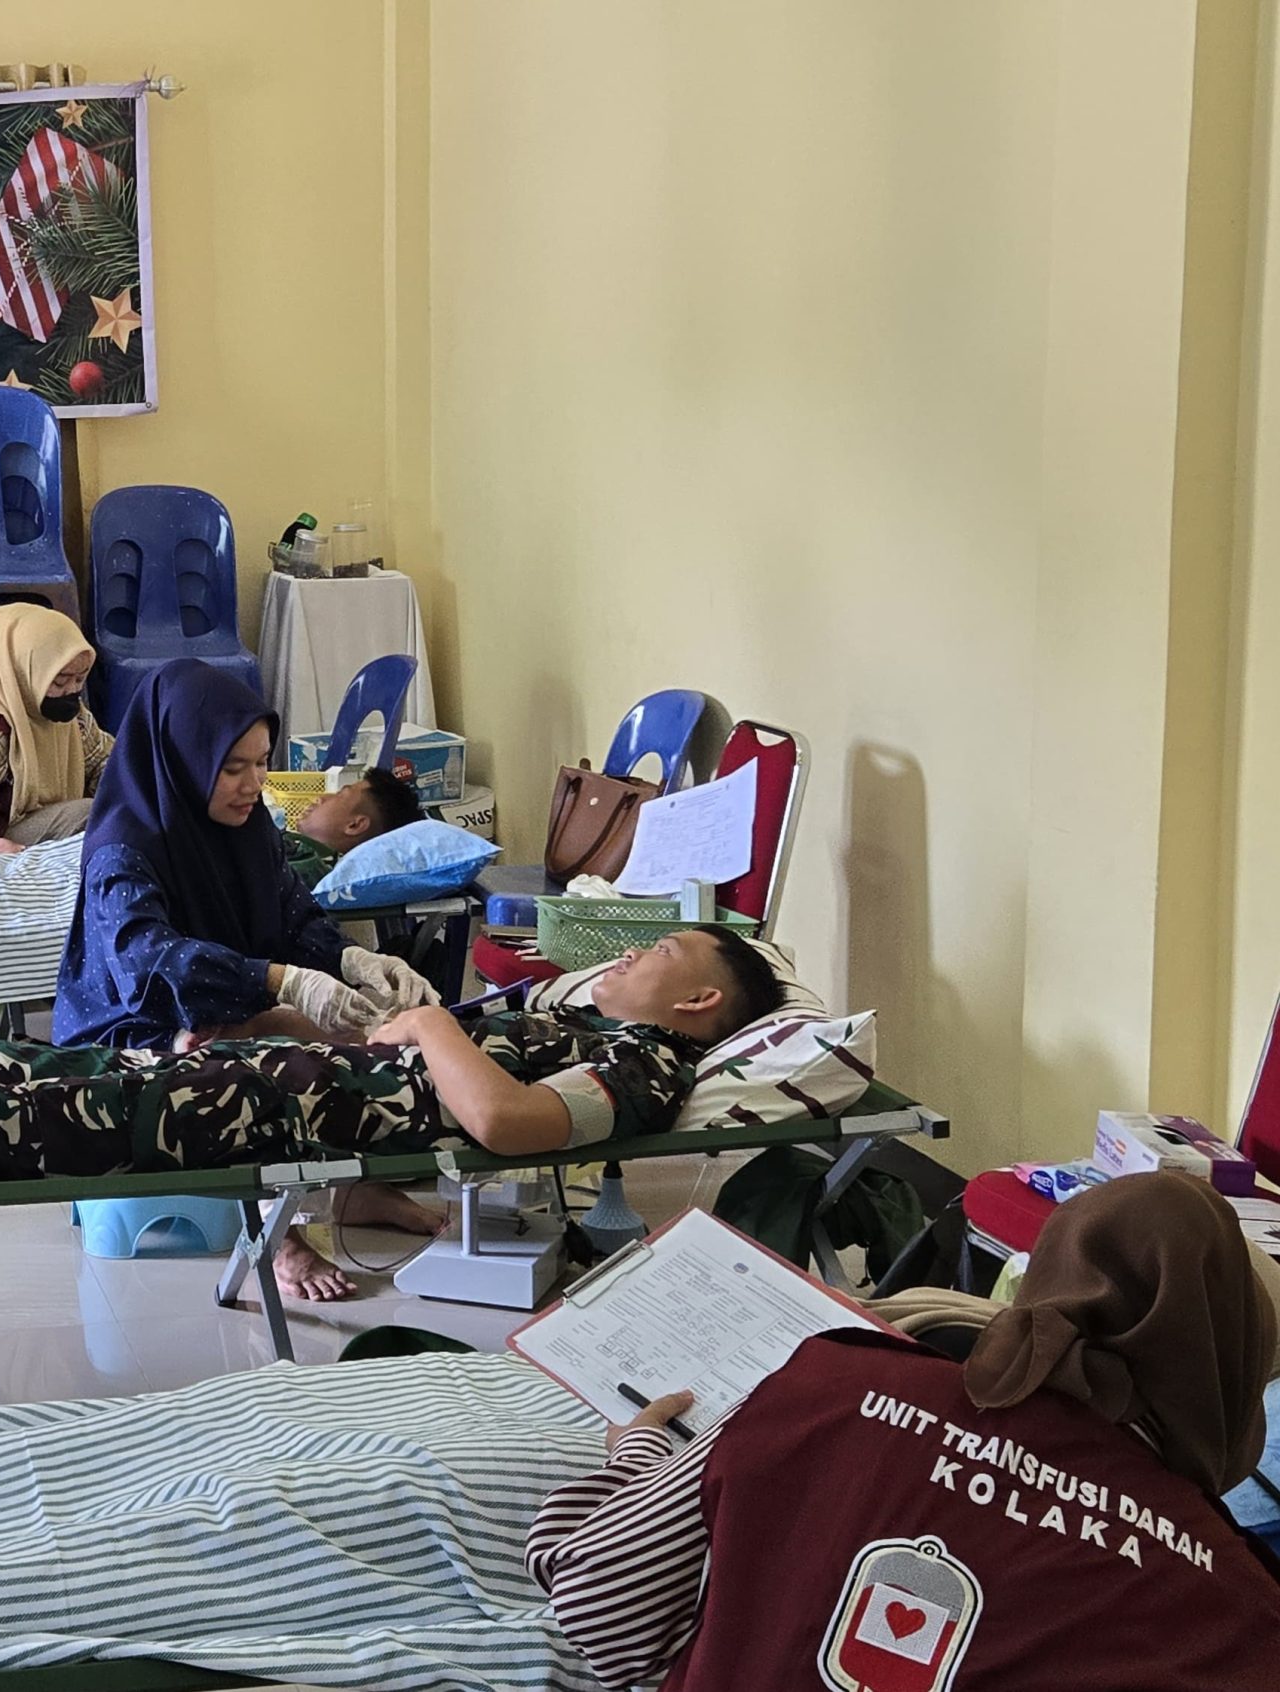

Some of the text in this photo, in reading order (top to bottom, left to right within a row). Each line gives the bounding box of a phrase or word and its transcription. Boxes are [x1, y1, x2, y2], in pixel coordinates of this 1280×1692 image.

[859, 1390, 1214, 1574] UNIT TRANSFUSI DARAH
[929, 1455, 1143, 1569] KOLAKA
